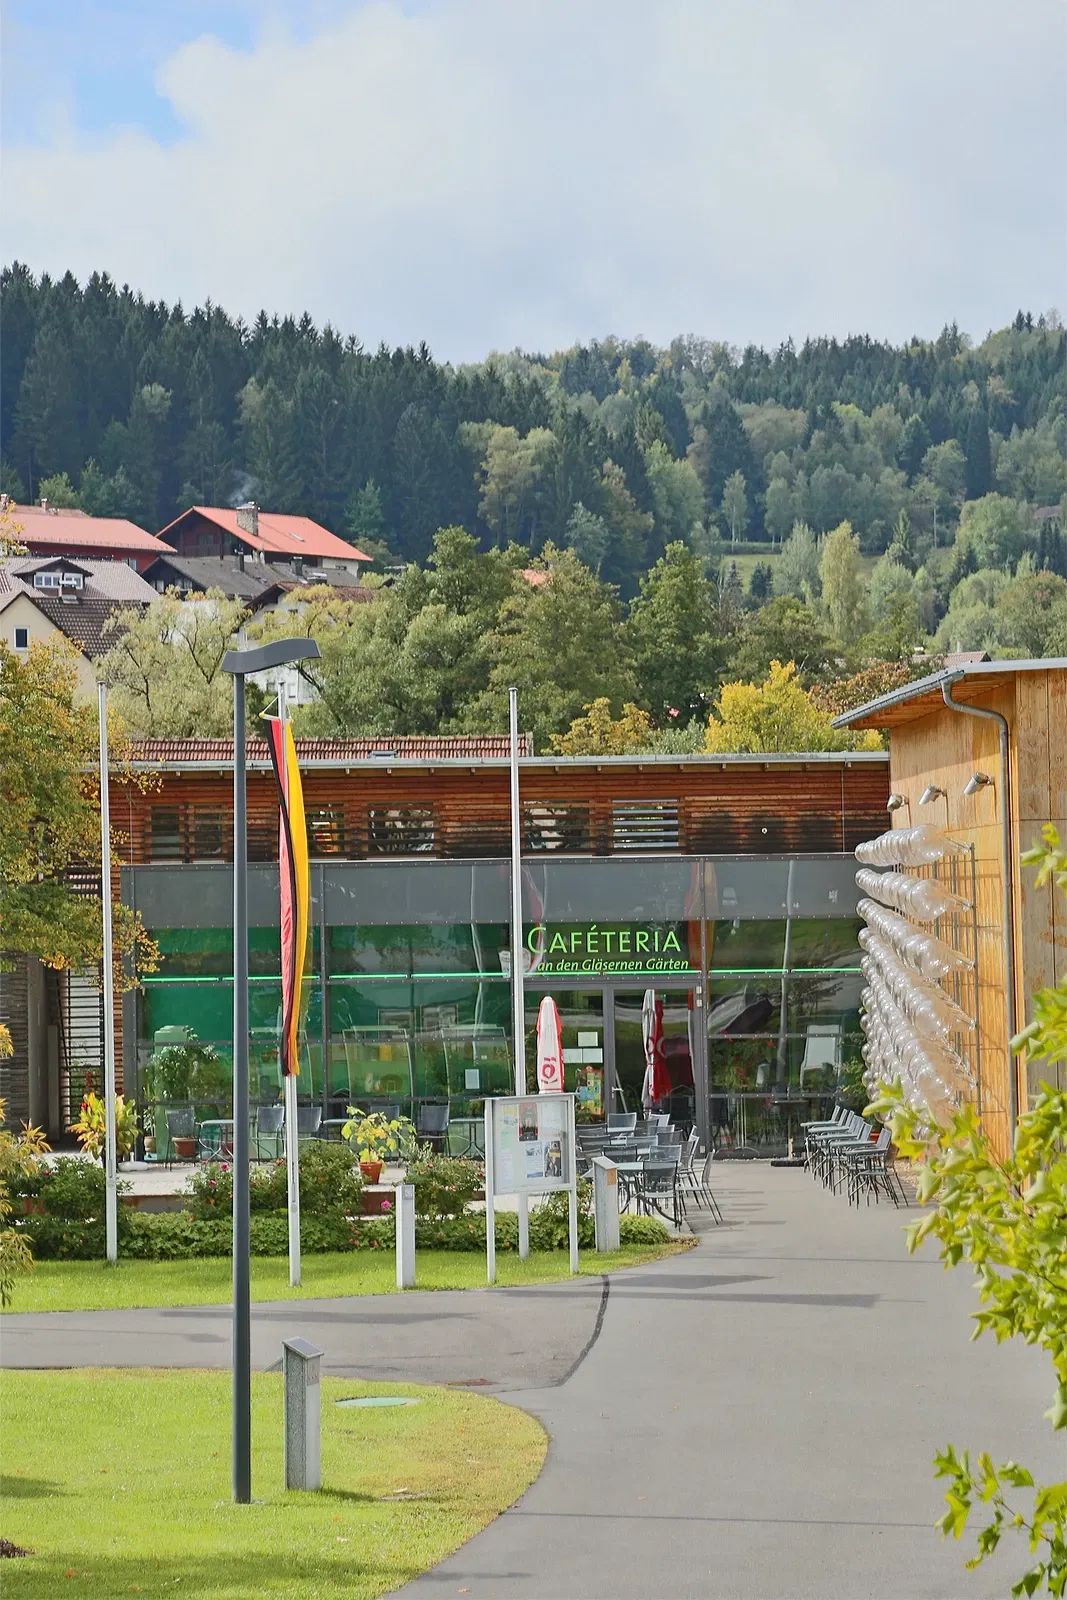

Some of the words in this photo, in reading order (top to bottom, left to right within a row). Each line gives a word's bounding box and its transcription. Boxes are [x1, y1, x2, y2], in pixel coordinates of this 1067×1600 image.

[527, 924, 681, 954] CAFÉTERIA
[537, 961, 553, 971] an
[556, 959, 578, 971] den
[582, 958, 642, 971] Gläsernen
[646, 957, 689, 970] Gärten
